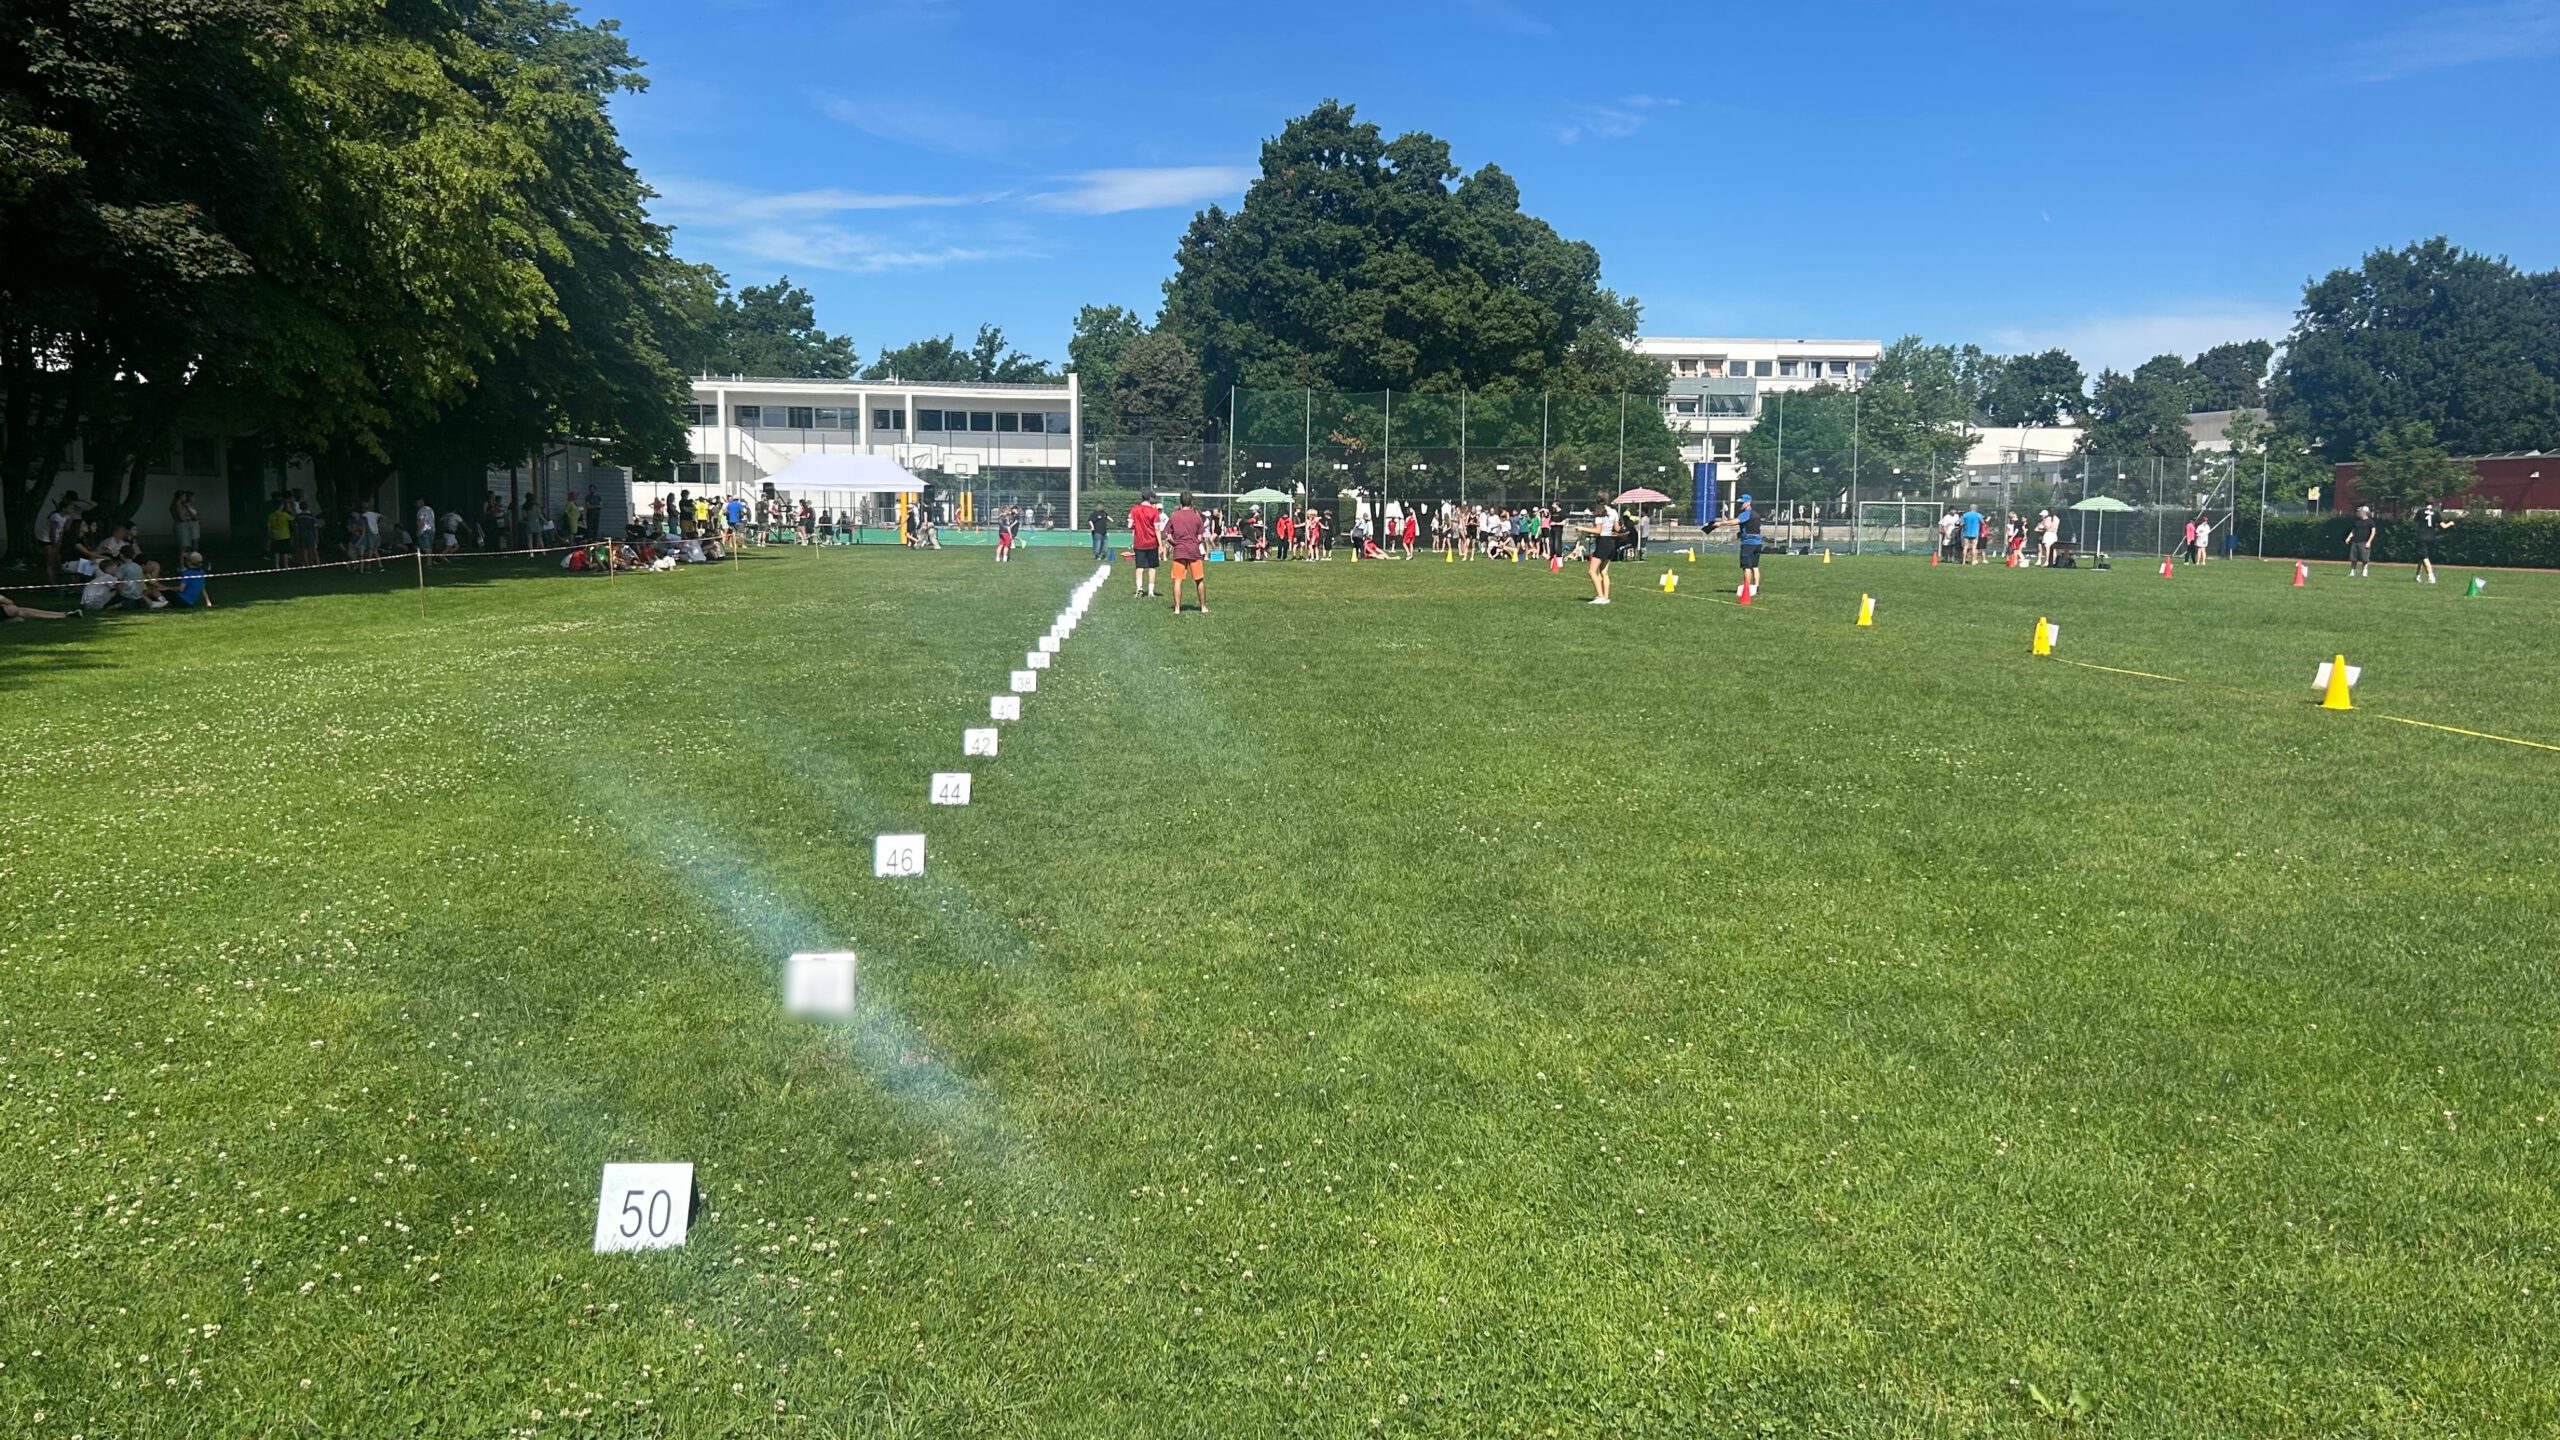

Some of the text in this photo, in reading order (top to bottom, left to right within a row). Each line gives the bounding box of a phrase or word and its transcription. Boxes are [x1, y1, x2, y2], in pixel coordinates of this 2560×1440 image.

[1017, 677, 1032, 690] 38
[997, 704, 1015, 719] 40
[972, 737, 991, 755] 42
[939, 783, 961, 803] 44
[886, 848, 914, 873] 46
[619, 1189, 672, 1239] 50
